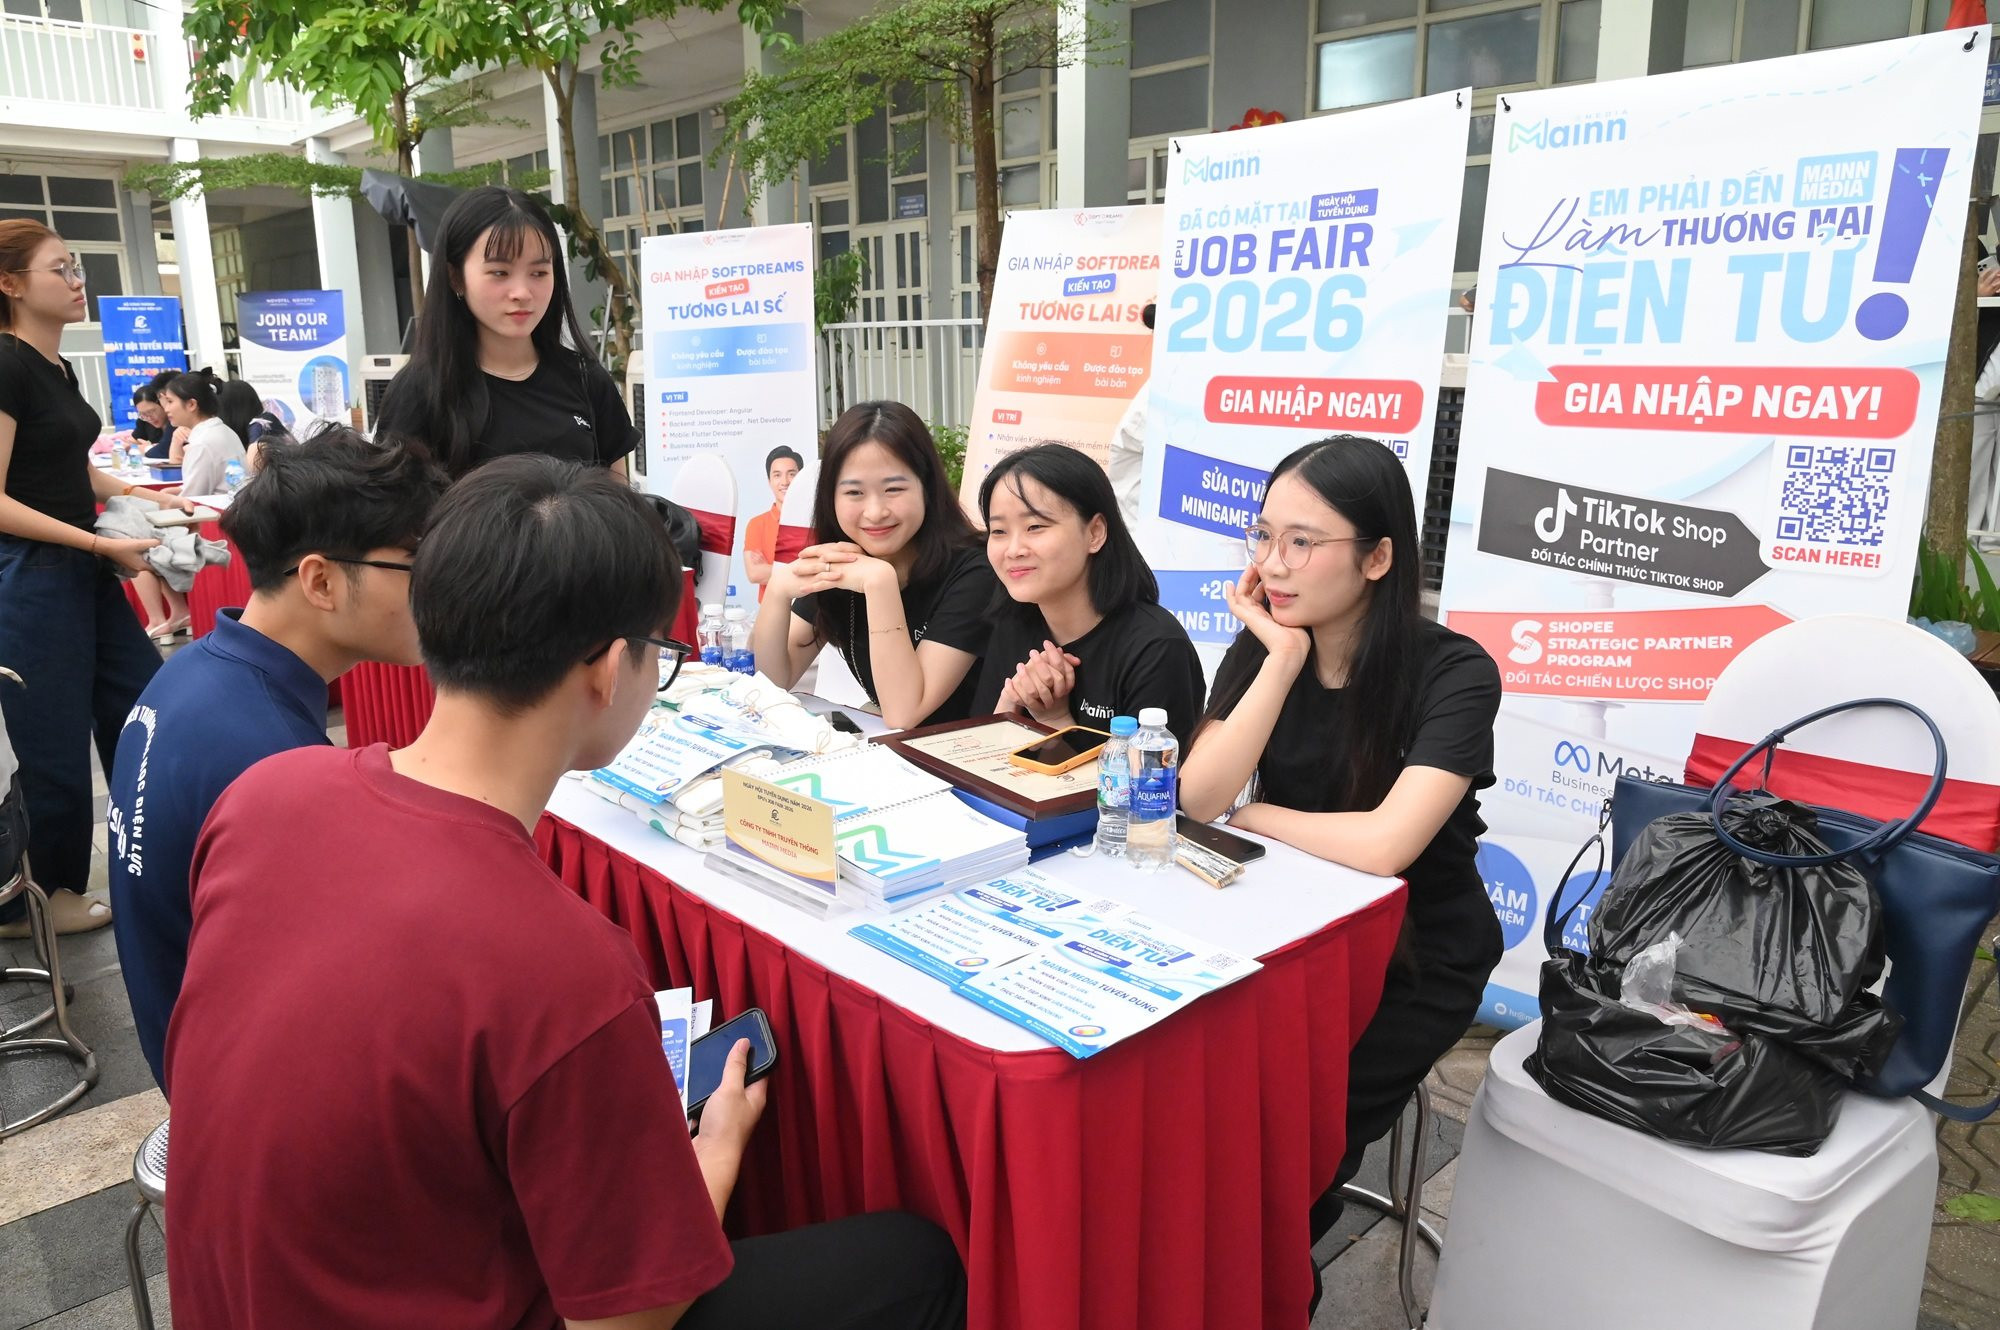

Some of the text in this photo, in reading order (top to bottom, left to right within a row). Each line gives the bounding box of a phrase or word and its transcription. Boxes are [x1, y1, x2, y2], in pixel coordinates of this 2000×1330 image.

[1508, 117, 1627, 153] Mainn
[1183, 155, 1260, 185] Mainn
[1802, 160, 1870, 184] MAINN
[1318, 194, 1356, 208] NGÀY HỘI
[1588, 167, 1785, 217] EM PHẢI ĐẾN
[1801, 178, 1864, 201] MEDIA
[1179, 200, 1308, 231] ĐÃ CÓ MẶT TẠI
[1345, 205, 1369, 216] DỤNG
[1499, 197, 1661, 273] Làm
[1663, 210, 1796, 247] THƯƠNG
[1174, 222, 1374, 278] JOB FAIR
[650, 260, 804, 284] GIA NHẬP SOFTDREAMS
[1008, 256, 1029, 271] GIA
[1033, 253, 1074, 274] NHẬP
[729, 283, 745, 295] TẠO
[1092, 278, 1111, 292] TẠO
[668, 302, 727, 320] TƯƠNG
[732, 299, 759, 316] LAI
[1019, 300, 1084, 321] TƯƠNG
[1088, 303, 1121, 322] LAI
[1489, 245, 1692, 356] ĐIỆN
[256, 312, 328, 326] JOIN OUR
[1167, 274, 1367, 353] 2026
[268, 328, 317, 341] TEAM!
[1012, 360, 1037, 372] Không
[1083, 362, 1106, 375] Được
[1128, 364, 1143, 376] tạo
[1219, 383, 1402, 422] GIA NHẬP NGAY!
[1564, 375, 1882, 424] GIA NHẬP NGAY!
[1202, 465, 1228, 495] SỬA
[1231, 477, 1250, 499] CV
[1181, 494, 1249, 529] MINIGAME
[1583, 495, 1727, 548] TikTok Shop
[1580, 530, 1659, 563] Partner
[1771, 545, 1881, 569] SCAN HERE!
[1530, 547, 1724, 592] ĐỐI TÁC CHÍNH THỨC TIKTOK SHOP
[1549, 620, 1614, 634] SHOPEE
[1548, 635, 1733, 651] STRATEGIC PARTNER
[1547, 653, 1632, 668] PROGRAM
[1505, 669, 1531, 685] ĐỐI
[1533, 670, 1562, 687] TÁC
[1564, 669, 1612, 688] CHIẾN
[1616, 674, 1663, 692] LƯỢC
[1137, 791, 1171, 801] AQUAFINA
[1504, 778, 1532, 798] ĐỐI
[1536, 786, 1567, 808] TÁC
[740, 818, 754, 830] CÔNG
[755, 824, 762, 832] TY
[763, 827, 777, 839] TNHH
[799, 841, 819, 856] THÔNG
